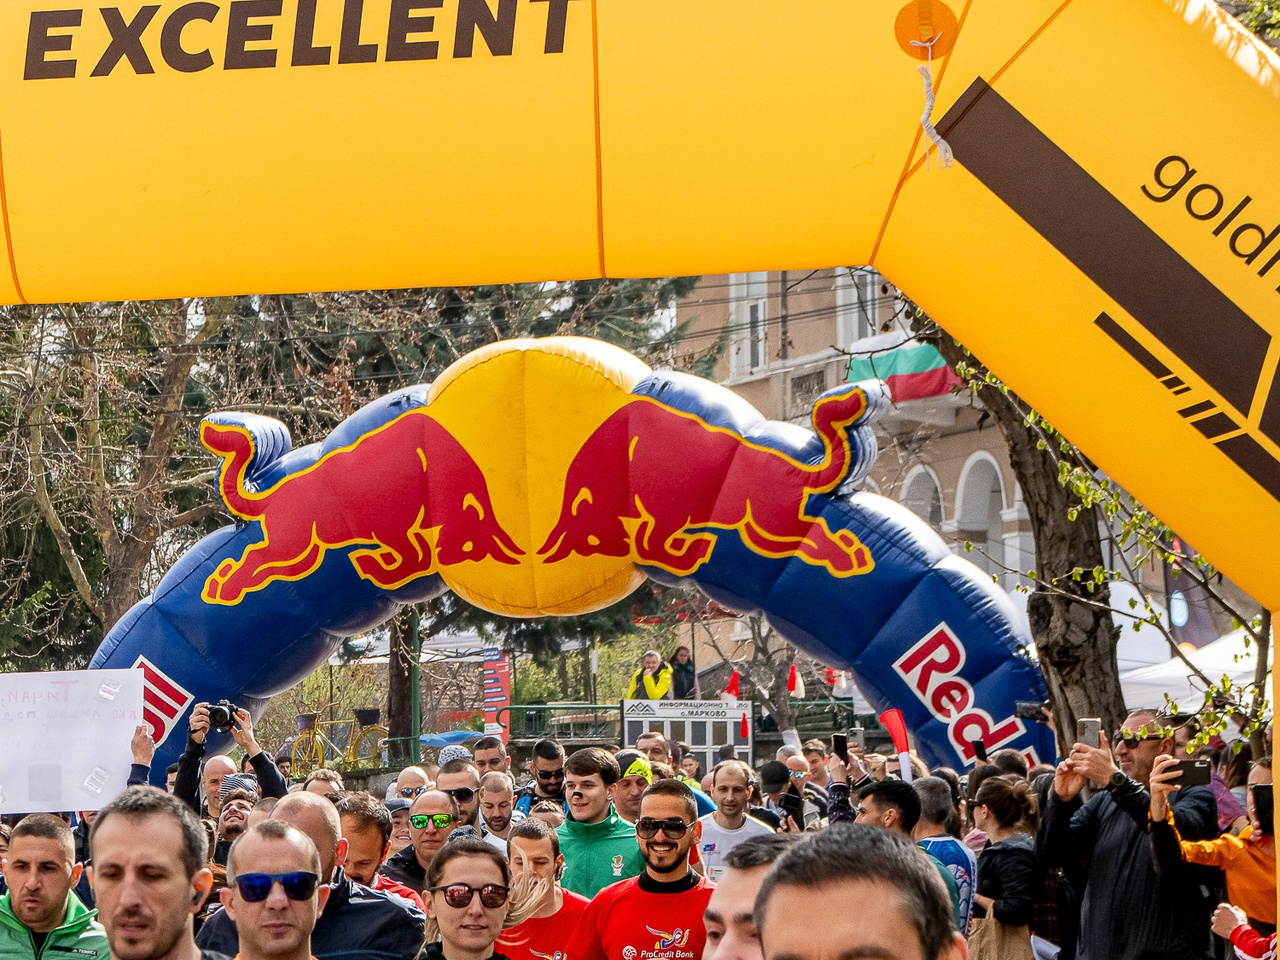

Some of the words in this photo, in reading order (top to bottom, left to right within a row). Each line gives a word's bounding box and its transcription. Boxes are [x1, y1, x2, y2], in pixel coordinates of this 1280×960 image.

[23, 0, 568, 81] EXCELLENT
[893, 624, 1025, 765] Red
[640, 950, 675, 959] ProCredit
[675, 951, 694, 959] Bank
